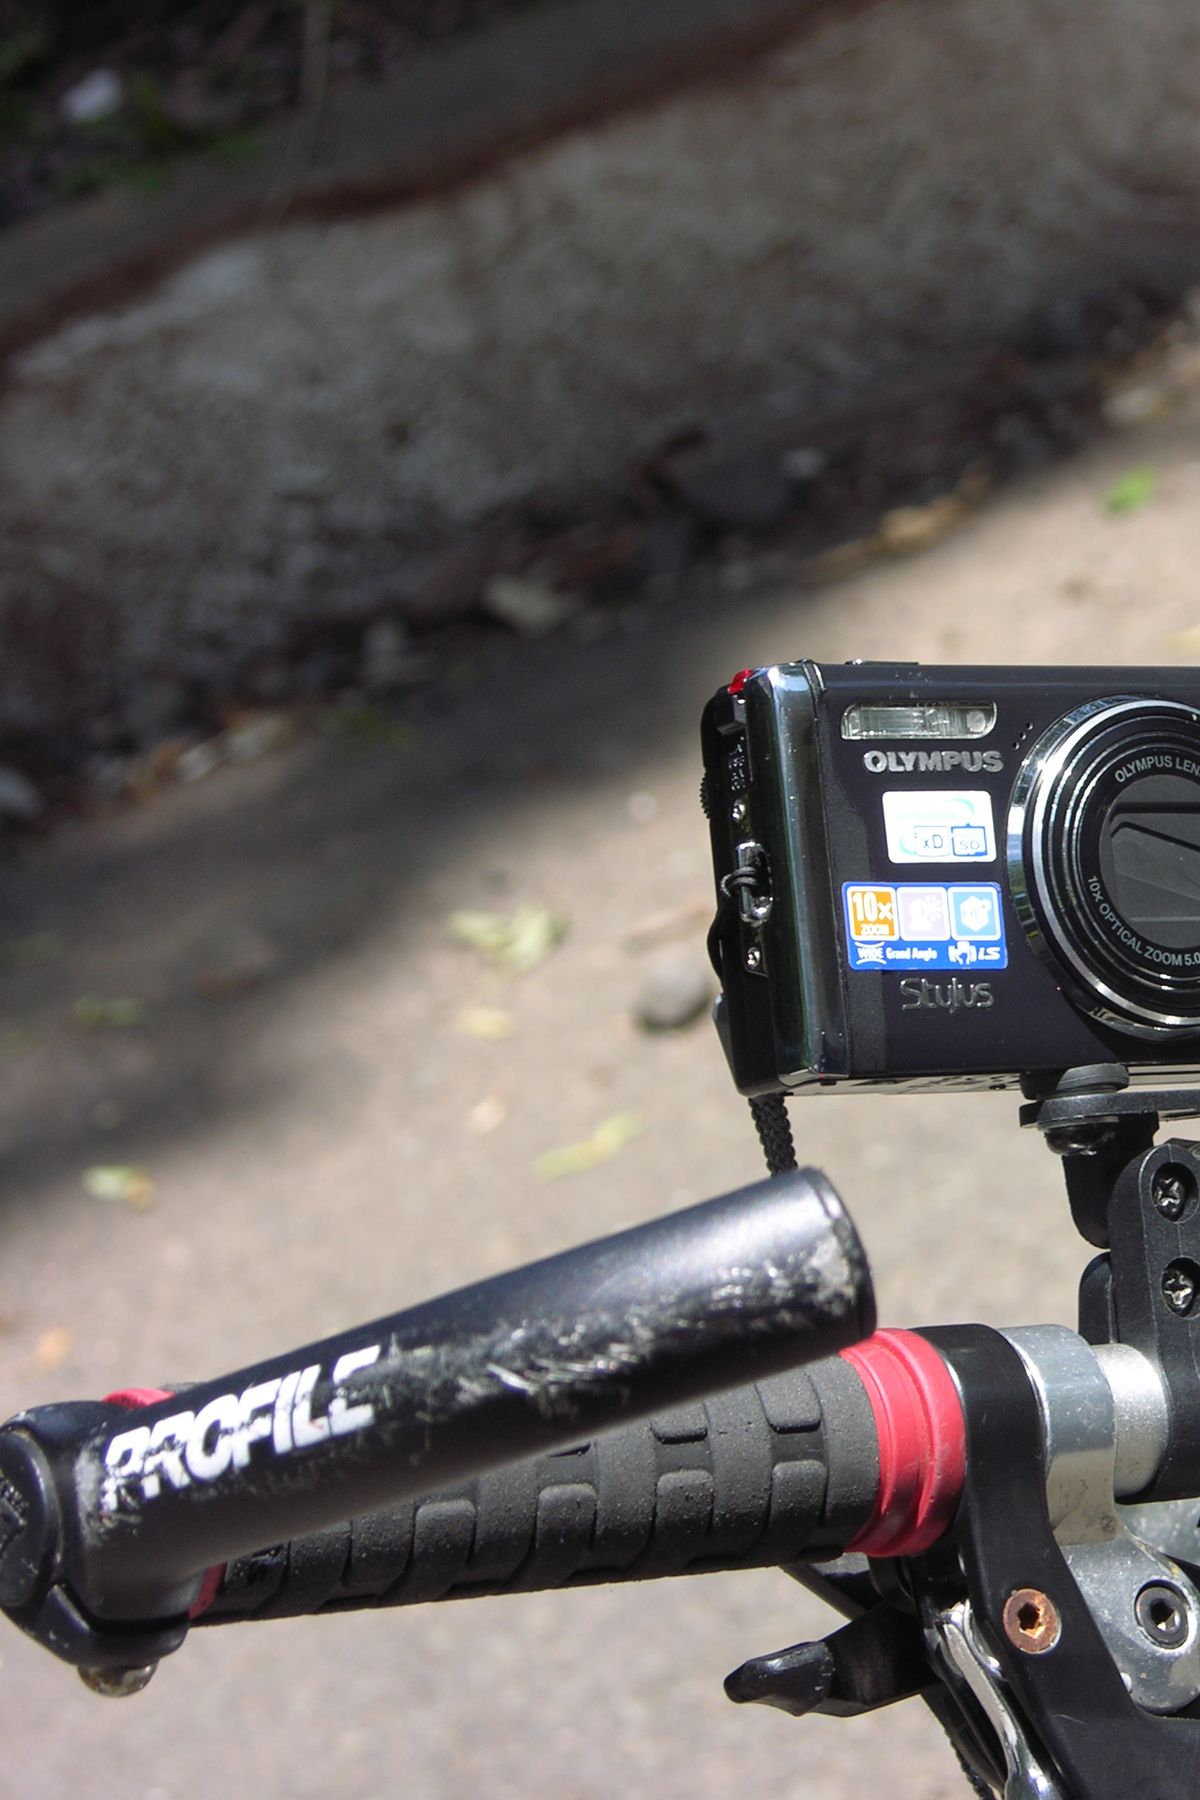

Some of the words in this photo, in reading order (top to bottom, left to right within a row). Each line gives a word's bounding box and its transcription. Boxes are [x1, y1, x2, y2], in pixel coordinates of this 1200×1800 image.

[863, 750, 1004, 773] OLYMPUS
[1114, 755, 1173, 783] OLYMPUS
[1099, 903, 1143, 954] OPTICAL
[1144, 945, 1183, 967] ZOOM
[900, 977, 995, 1014] Stylus
[101, 1344, 381, 1511] PROFILE
